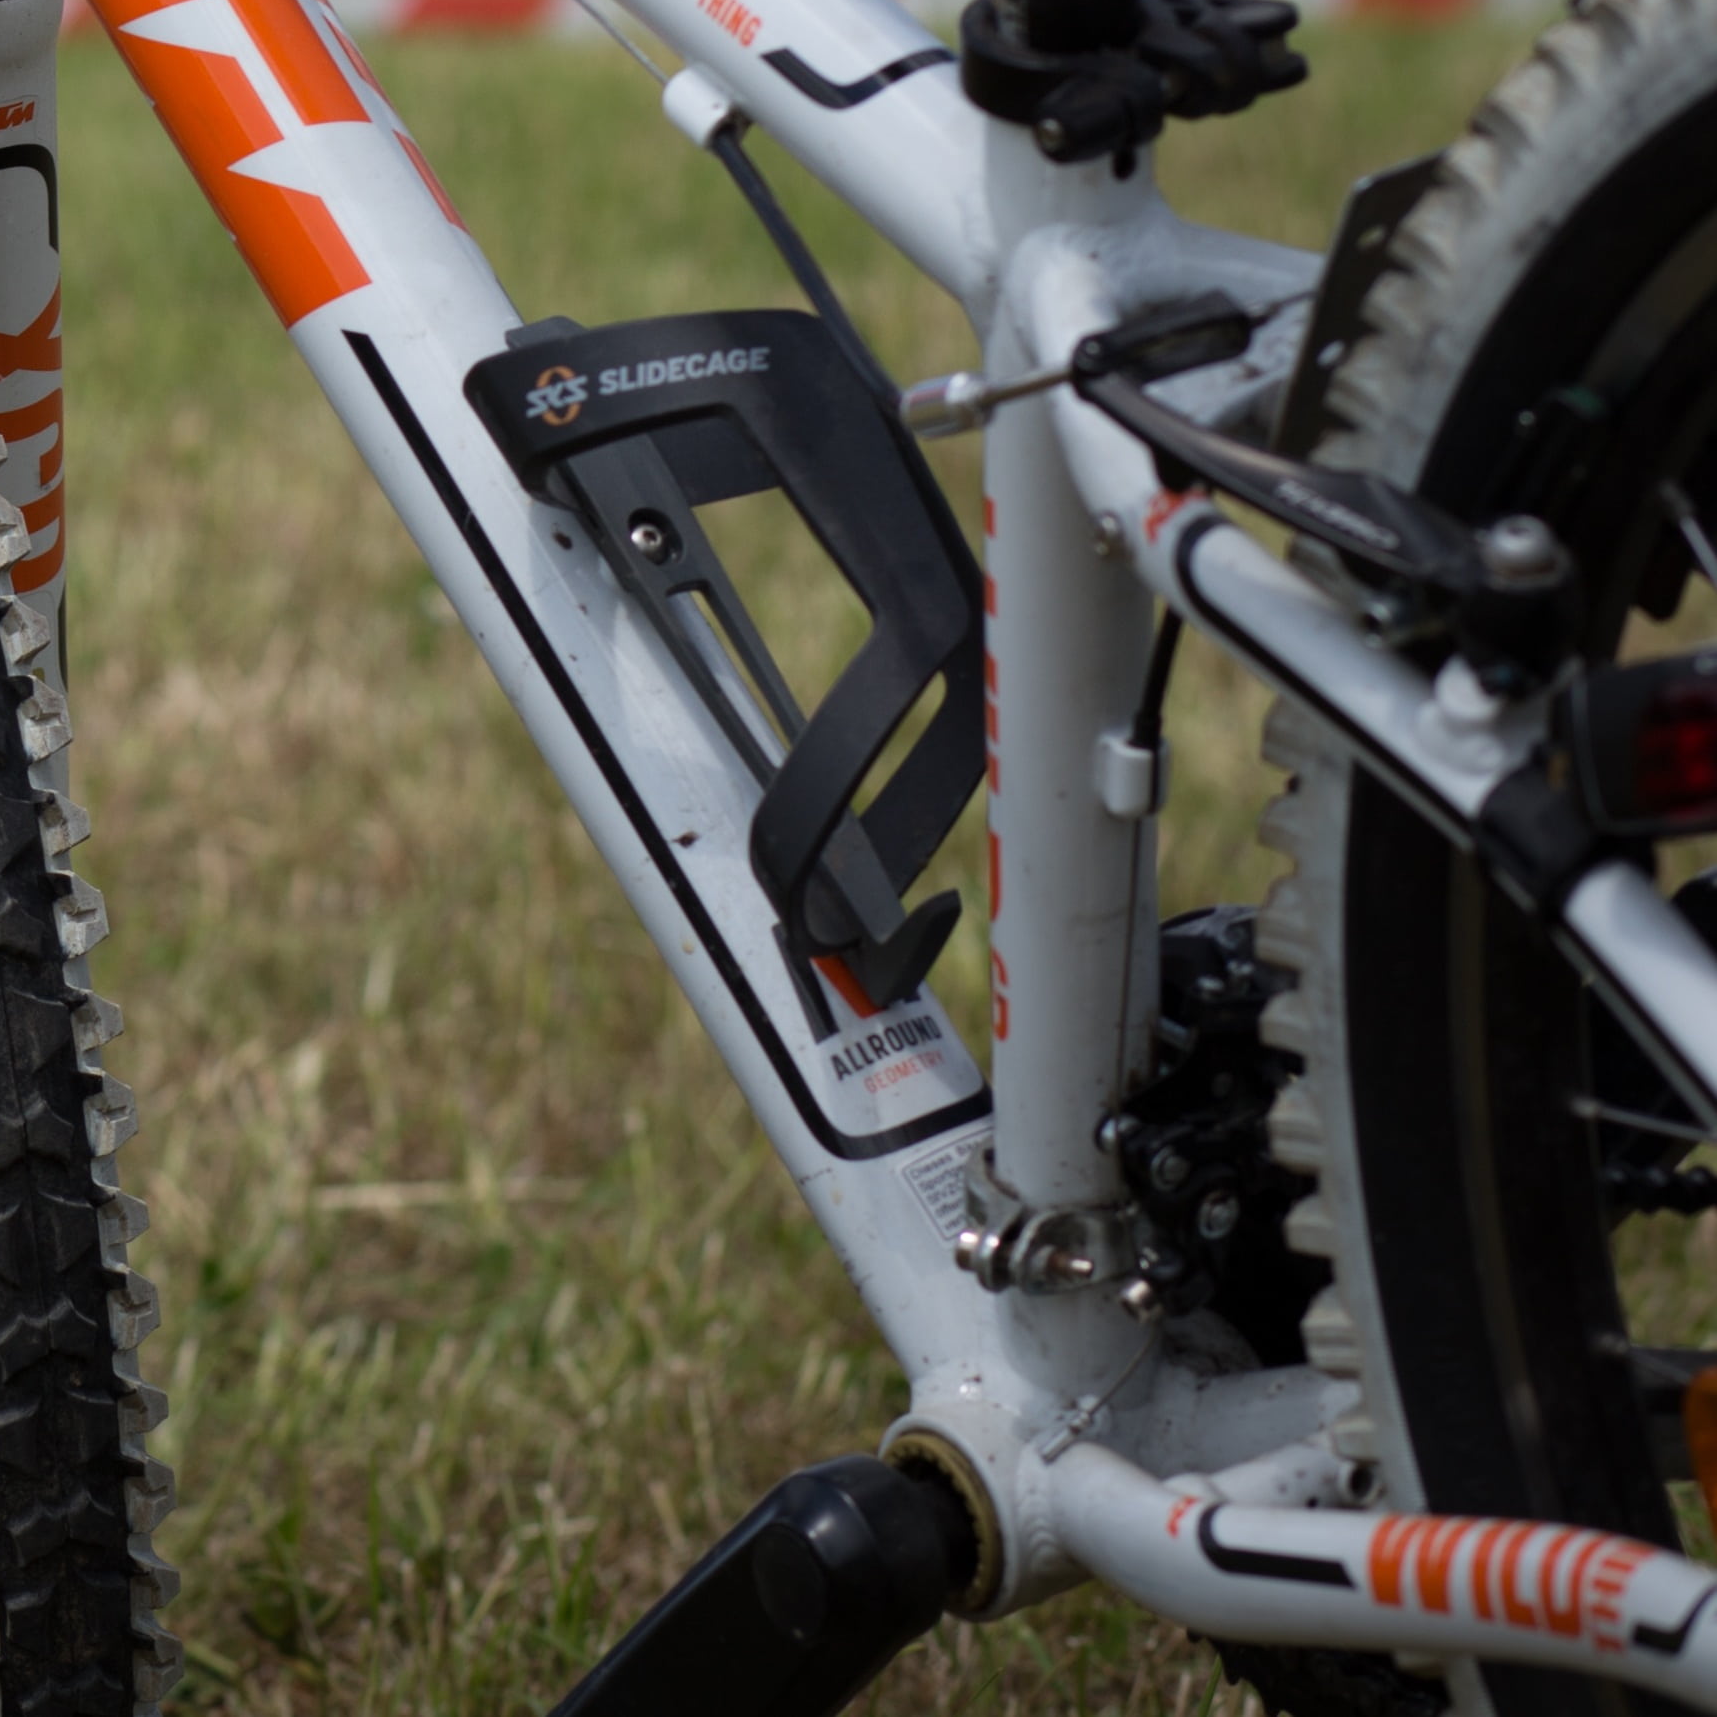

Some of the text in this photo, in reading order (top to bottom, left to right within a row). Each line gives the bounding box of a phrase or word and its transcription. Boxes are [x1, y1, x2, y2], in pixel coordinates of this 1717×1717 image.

[598, 346, 771, 396] SLIDECAGE
[830, 1014, 943, 1082] ALLROUND
[863, 1050, 946, 1095] GEOMETRY
